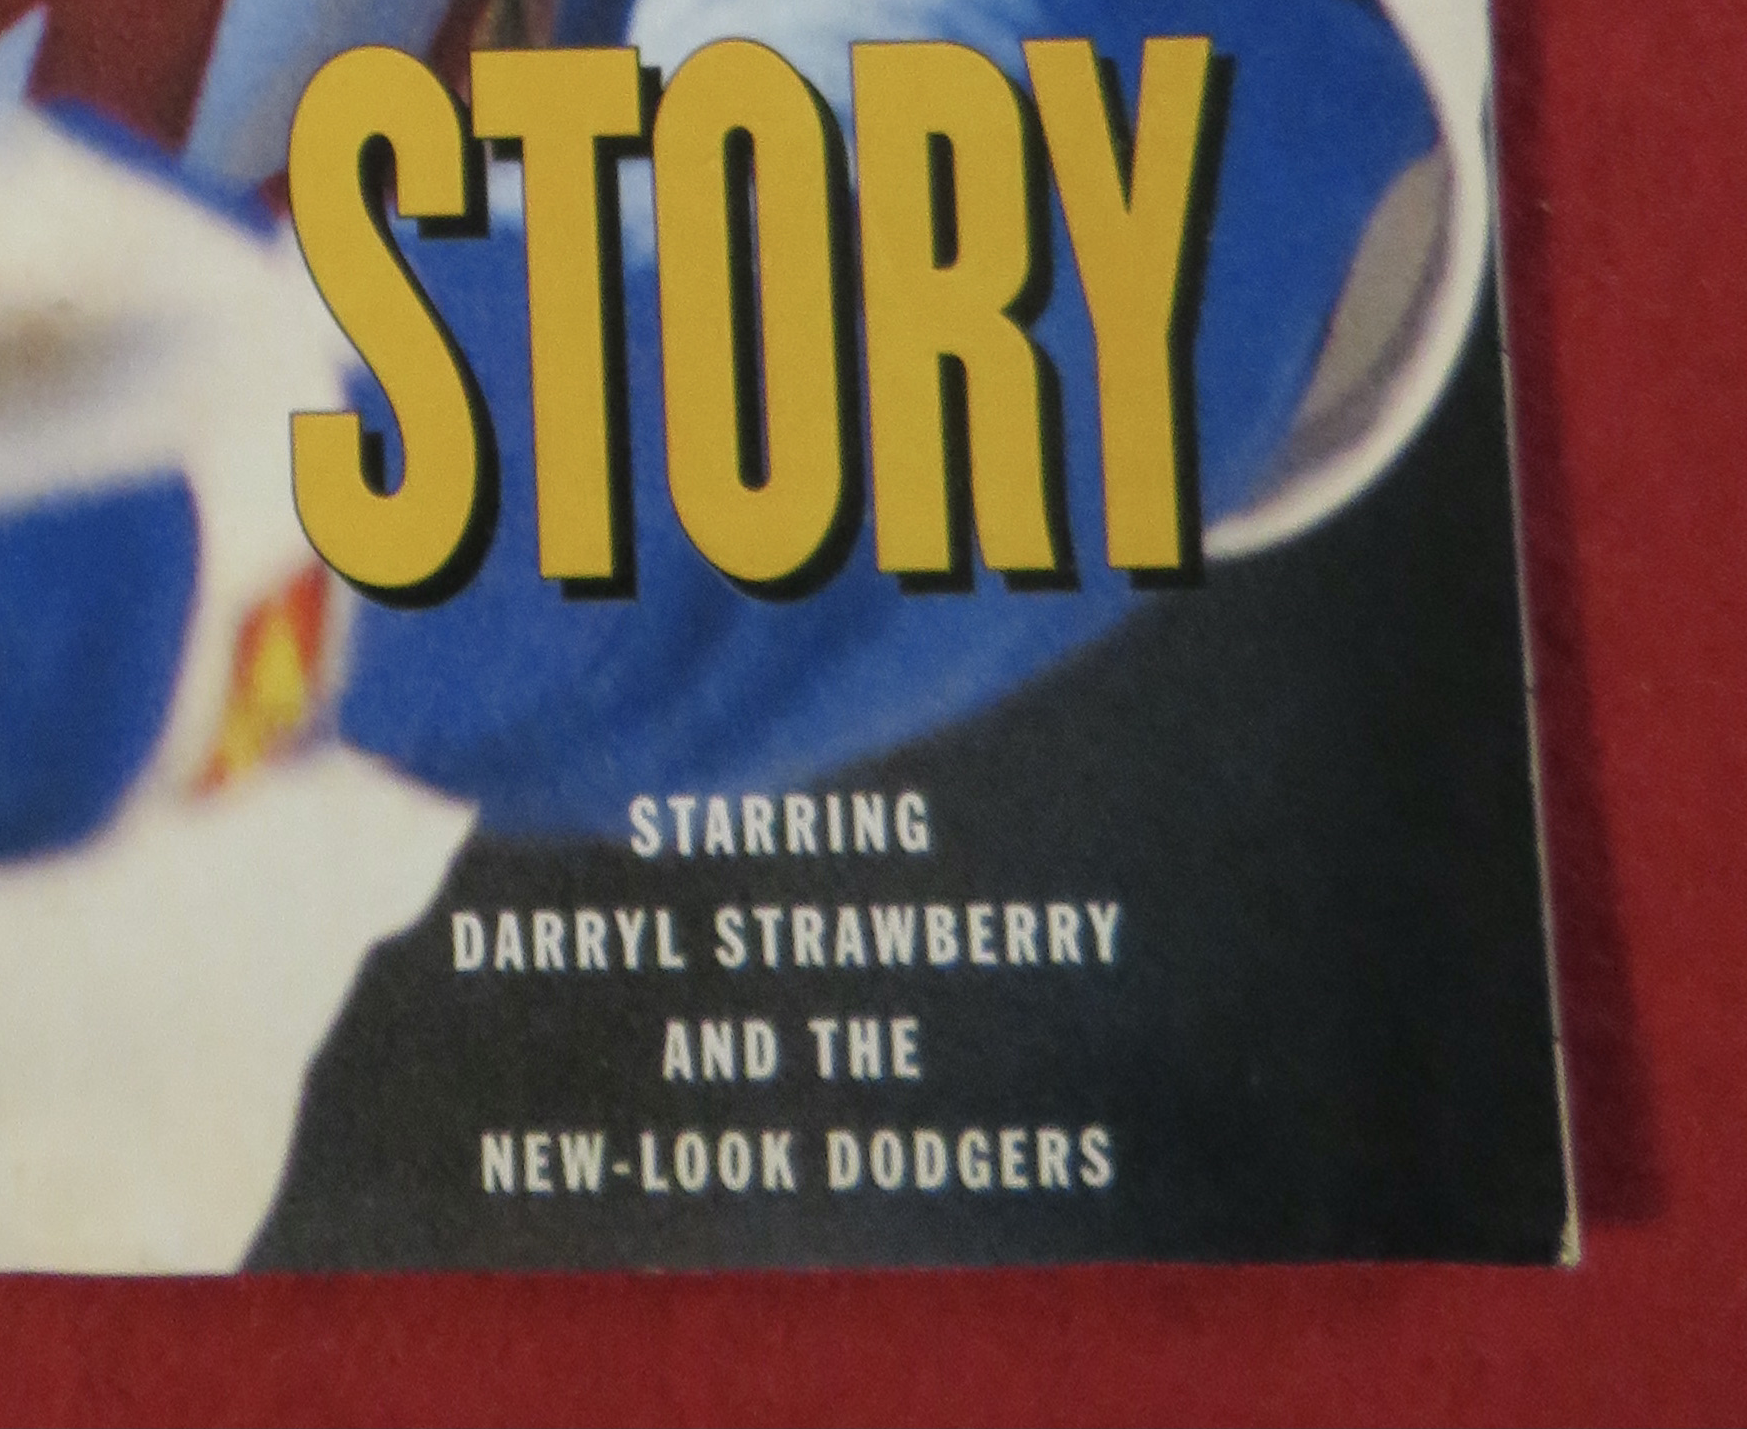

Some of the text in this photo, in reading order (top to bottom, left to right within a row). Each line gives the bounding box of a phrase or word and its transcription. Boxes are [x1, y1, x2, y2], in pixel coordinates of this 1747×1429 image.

[289, 35, 1228, 604] STORY
[629, 791, 932, 858] STARRING
[452, 900, 1121, 973] DARRYL STRAWBERRY
[661, 1016, 922, 1083] AND THE
[479, 1124, 1115, 1195] NEW-LOOK DODGERS
